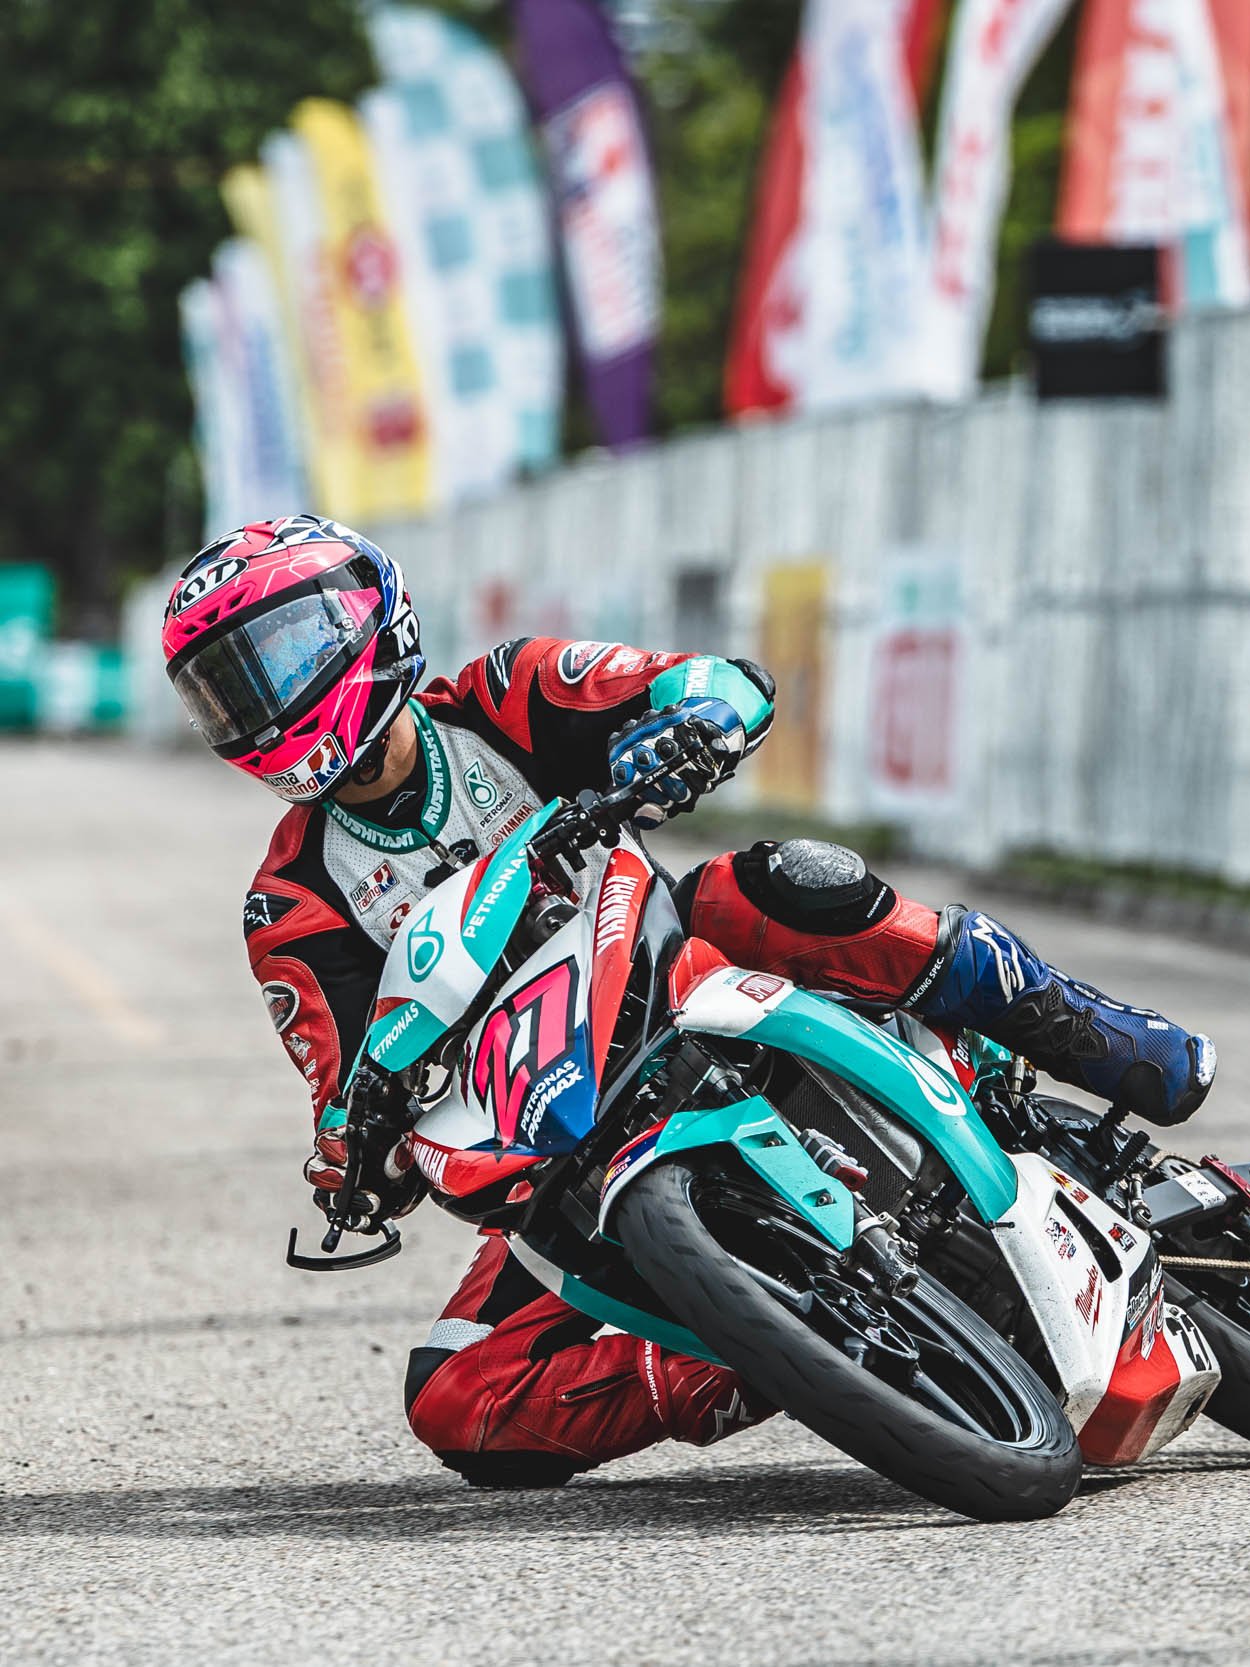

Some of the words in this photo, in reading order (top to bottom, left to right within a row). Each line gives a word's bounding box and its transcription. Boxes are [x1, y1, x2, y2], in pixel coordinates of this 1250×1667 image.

[180, 558, 234, 603] KYT
[479, 791, 513, 828] PETRONAS
[498, 804, 533, 838] YAMAHA
[352, 881, 370, 902] uma
[357, 885, 382, 910] racing
[596, 875, 640, 957] YAMAHA
[909, 977, 932, 1003] RACING
[929, 956, 945, 979] SPEC.
[520, 1060, 576, 1132] PETRONAS
[528, 1065, 585, 1146] PRIMAX
[644, 1356, 659, 1400] KUSHITANI
